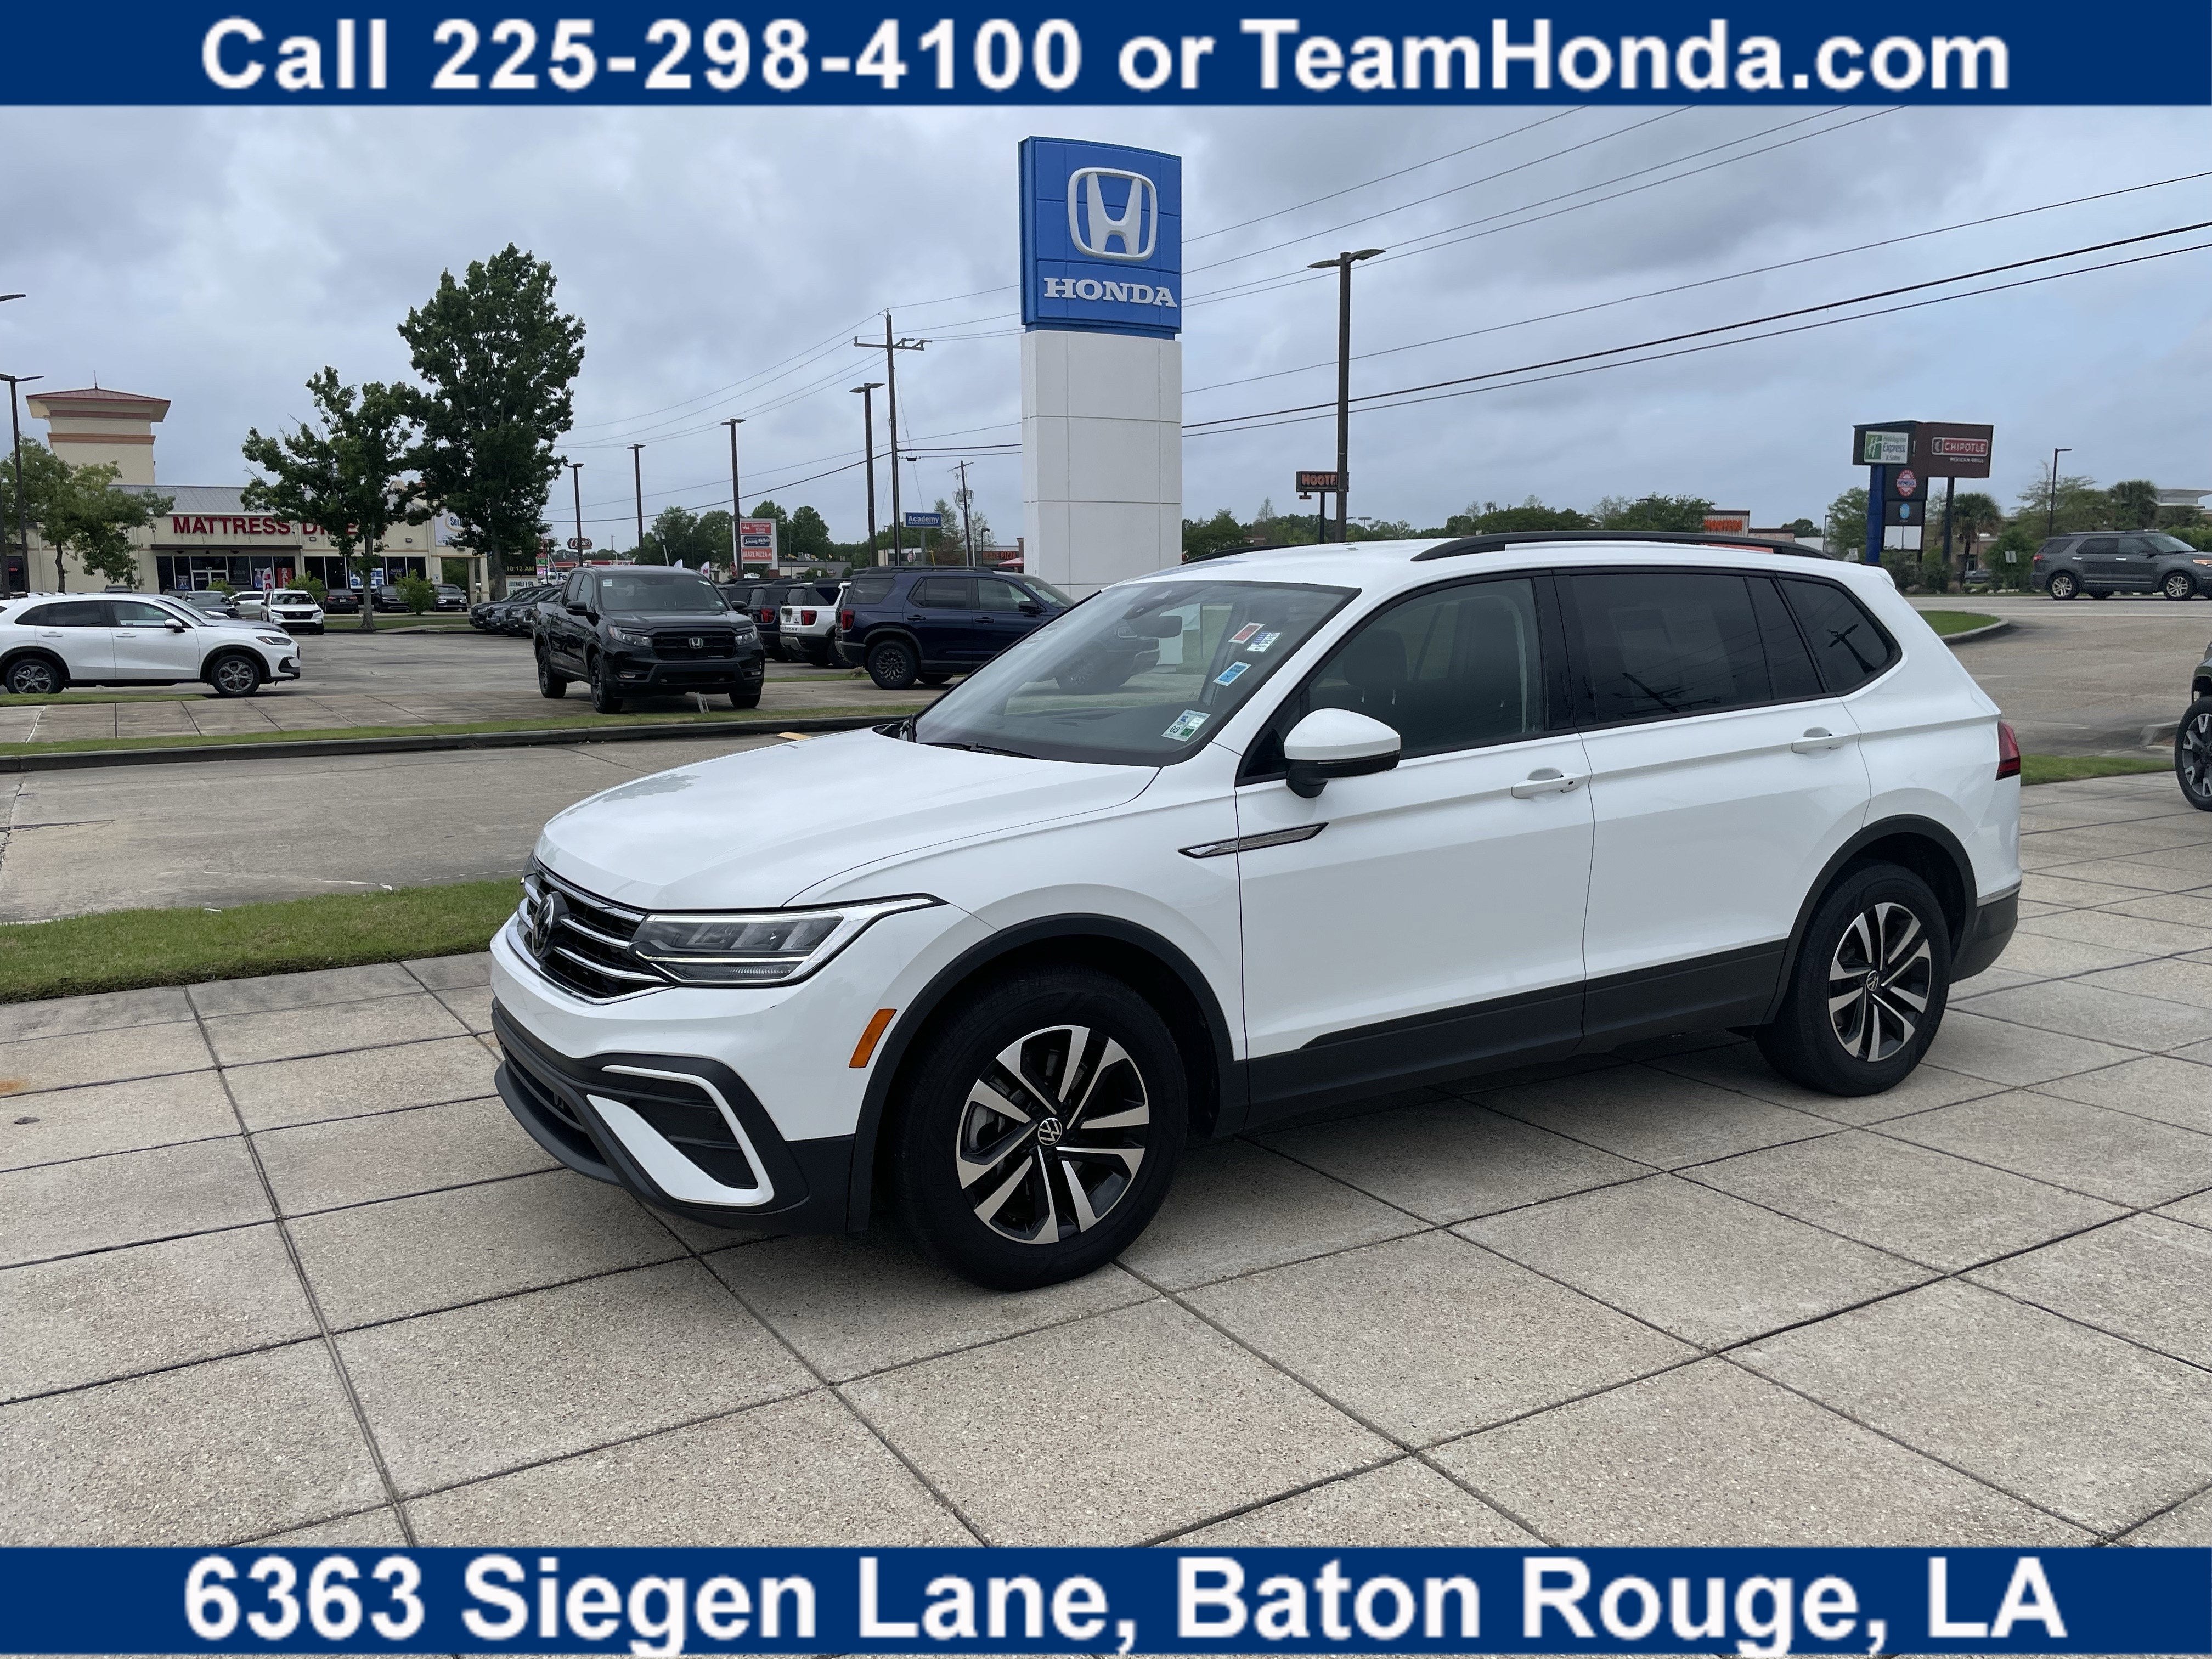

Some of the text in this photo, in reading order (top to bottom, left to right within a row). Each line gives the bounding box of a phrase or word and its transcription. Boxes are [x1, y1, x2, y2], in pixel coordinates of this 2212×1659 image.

[1044, 278, 1177, 308] HONDA
[1883, 442, 1906, 453] Express
[1945, 442, 1985, 452] CHIPOTLE
[908, 515, 939, 524] Academy
[173, 517, 291, 534] MATTRESS
